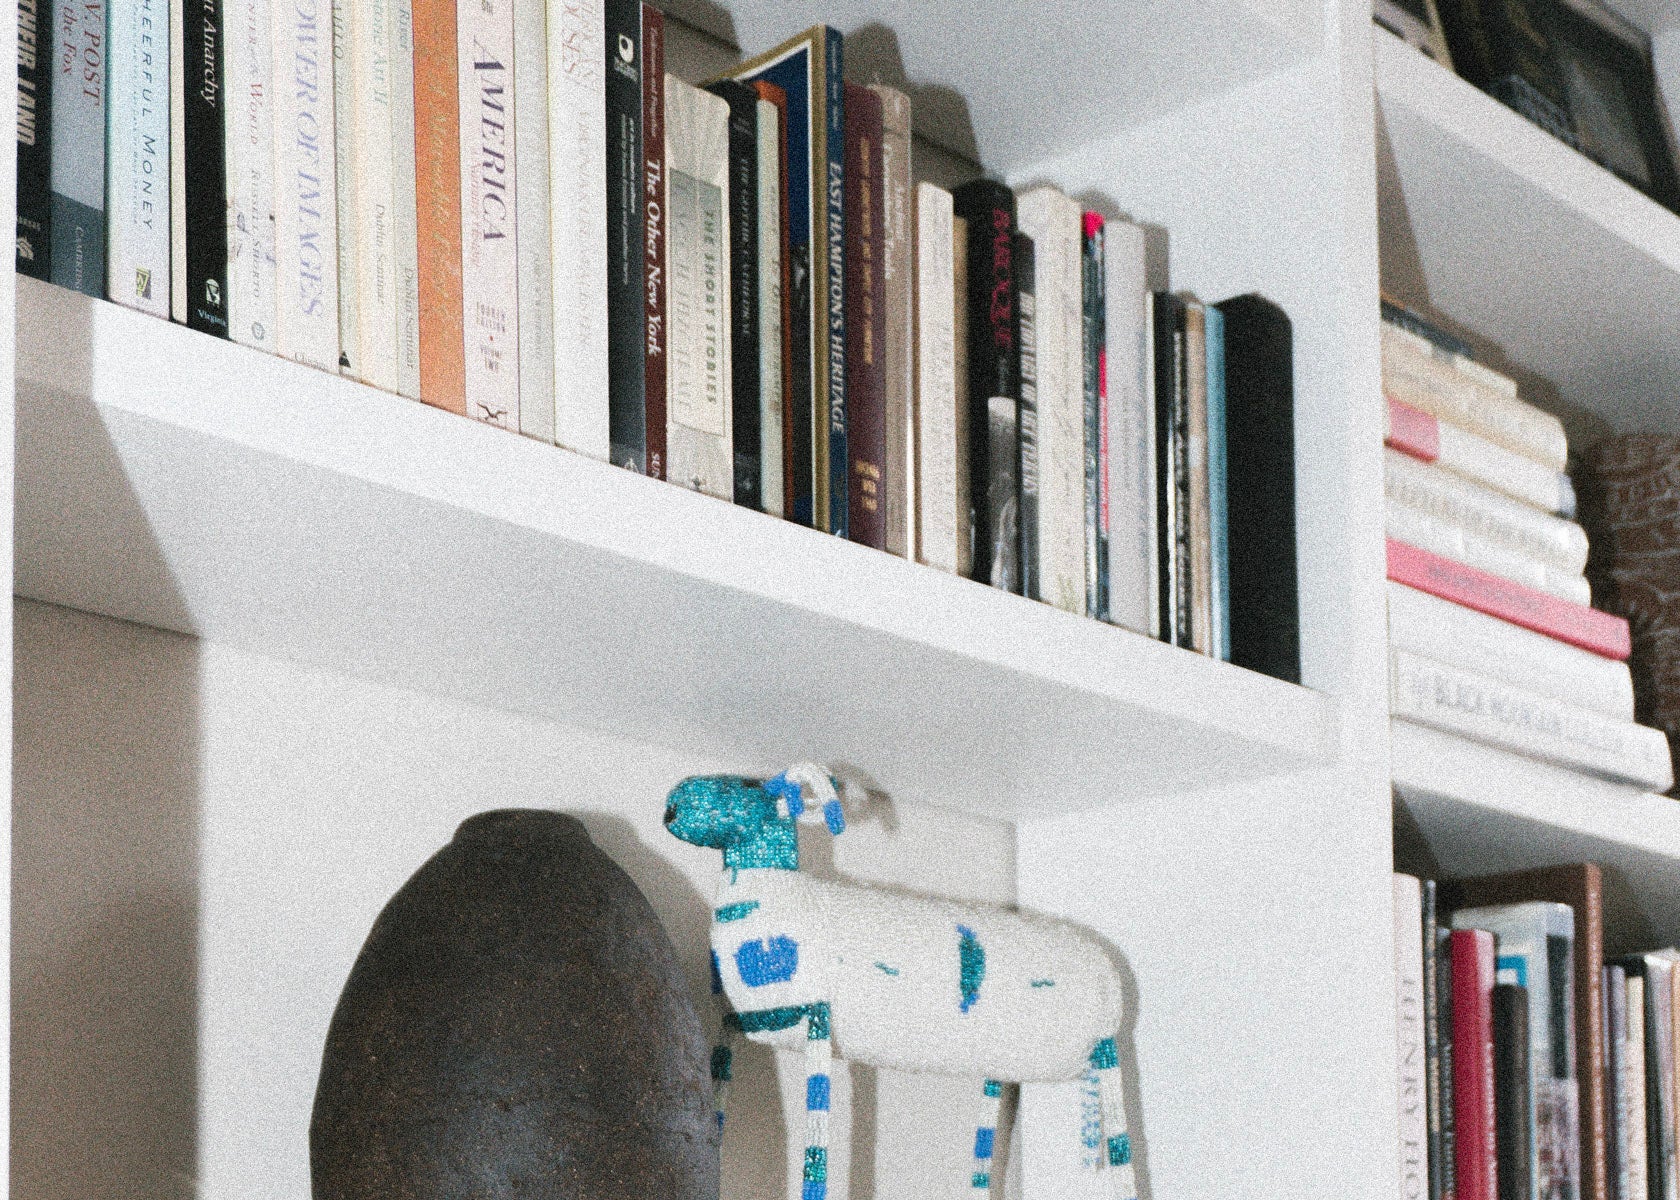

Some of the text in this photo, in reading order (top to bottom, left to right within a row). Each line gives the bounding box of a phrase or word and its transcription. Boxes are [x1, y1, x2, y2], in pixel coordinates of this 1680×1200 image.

[63, 6, 77, 76] the Fox
[84, 31, 102, 106] POST
[200, 17, 219, 108] Anarchy
[18, 77, 36, 146] LAND
[250, 83, 263, 146] WORLD
[474, 36, 506, 241] AMERICA
[142, 134, 157, 230] MONEY
[297, 112, 322, 317] OF IMAGES
[376, 204, 386, 247] Dublin
[399, 9, 417, 369] River Dublin Seminar
[376, 252, 387, 305] Seminar
[647, 160, 662, 356] The Other New York
[829, 162, 845, 431] EAST HAMPTON'S HERITAGE
[704, 211, 717, 406] THE SHORT STORIES
[1402, 976, 1419, 1123] HENRY
